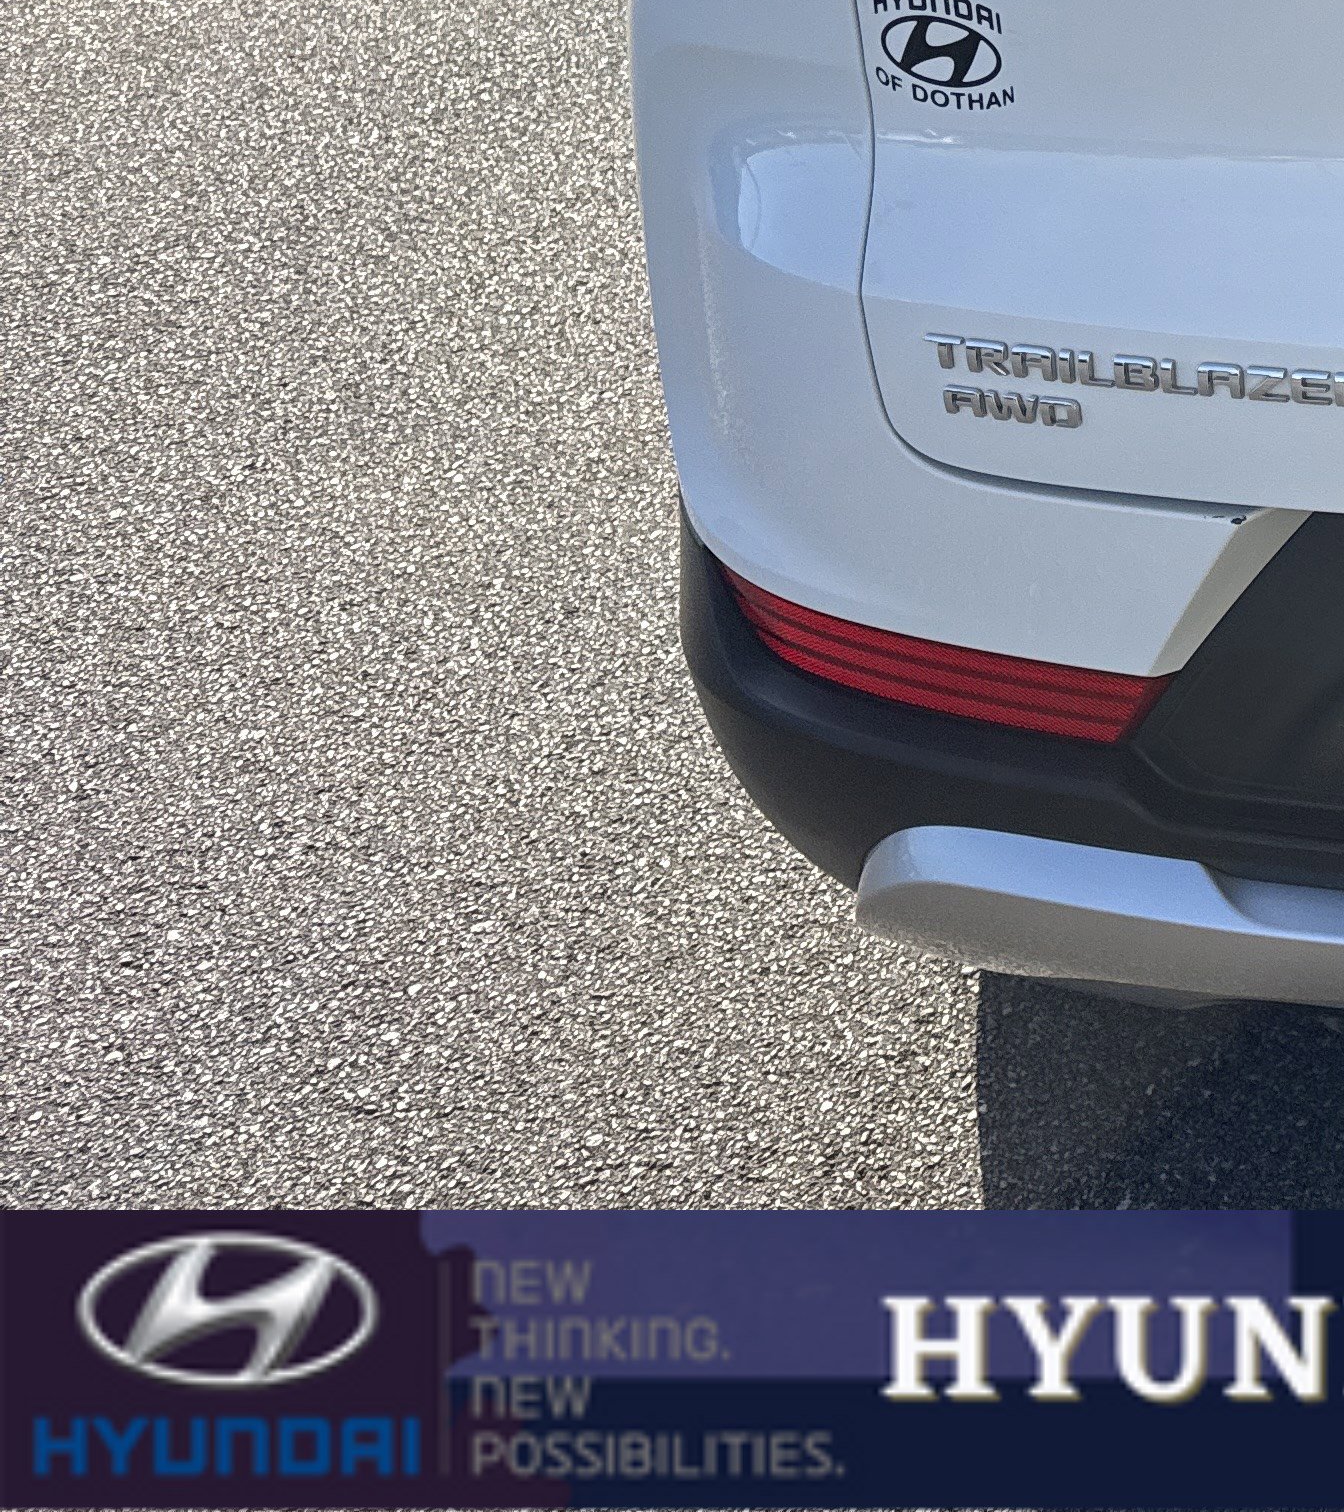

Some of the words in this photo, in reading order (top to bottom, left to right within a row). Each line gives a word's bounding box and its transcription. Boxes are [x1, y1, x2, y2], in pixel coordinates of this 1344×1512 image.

[875, 66, 902, 91] OF
[912, 86, 1014, 110] DOTHAN
[942, 384, 1083, 428] AWD
